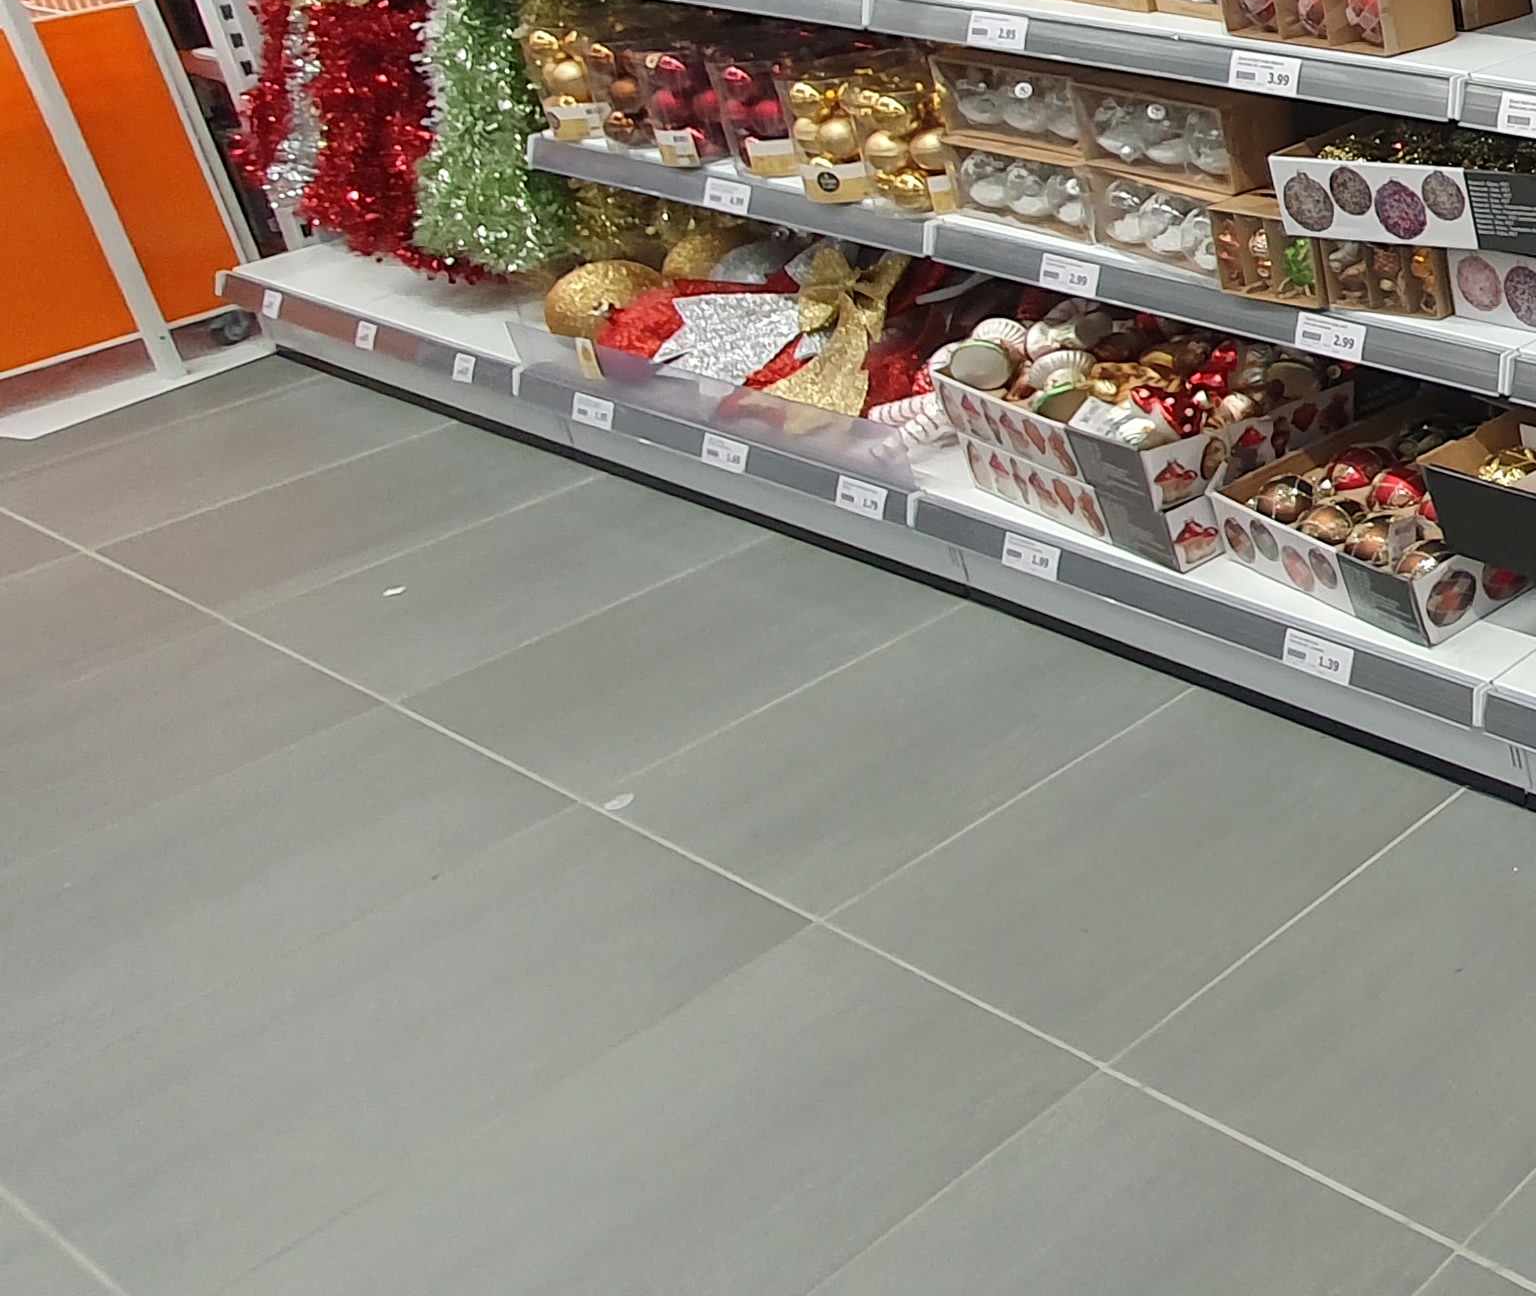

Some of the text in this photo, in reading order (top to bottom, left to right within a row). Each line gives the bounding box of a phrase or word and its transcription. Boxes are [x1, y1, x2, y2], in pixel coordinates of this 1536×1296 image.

[1267, 72, 1290, 86] 3.99
[1333, 334, 1355, 349] 2.99
[1317, 655, 1340, 673] 1.39
